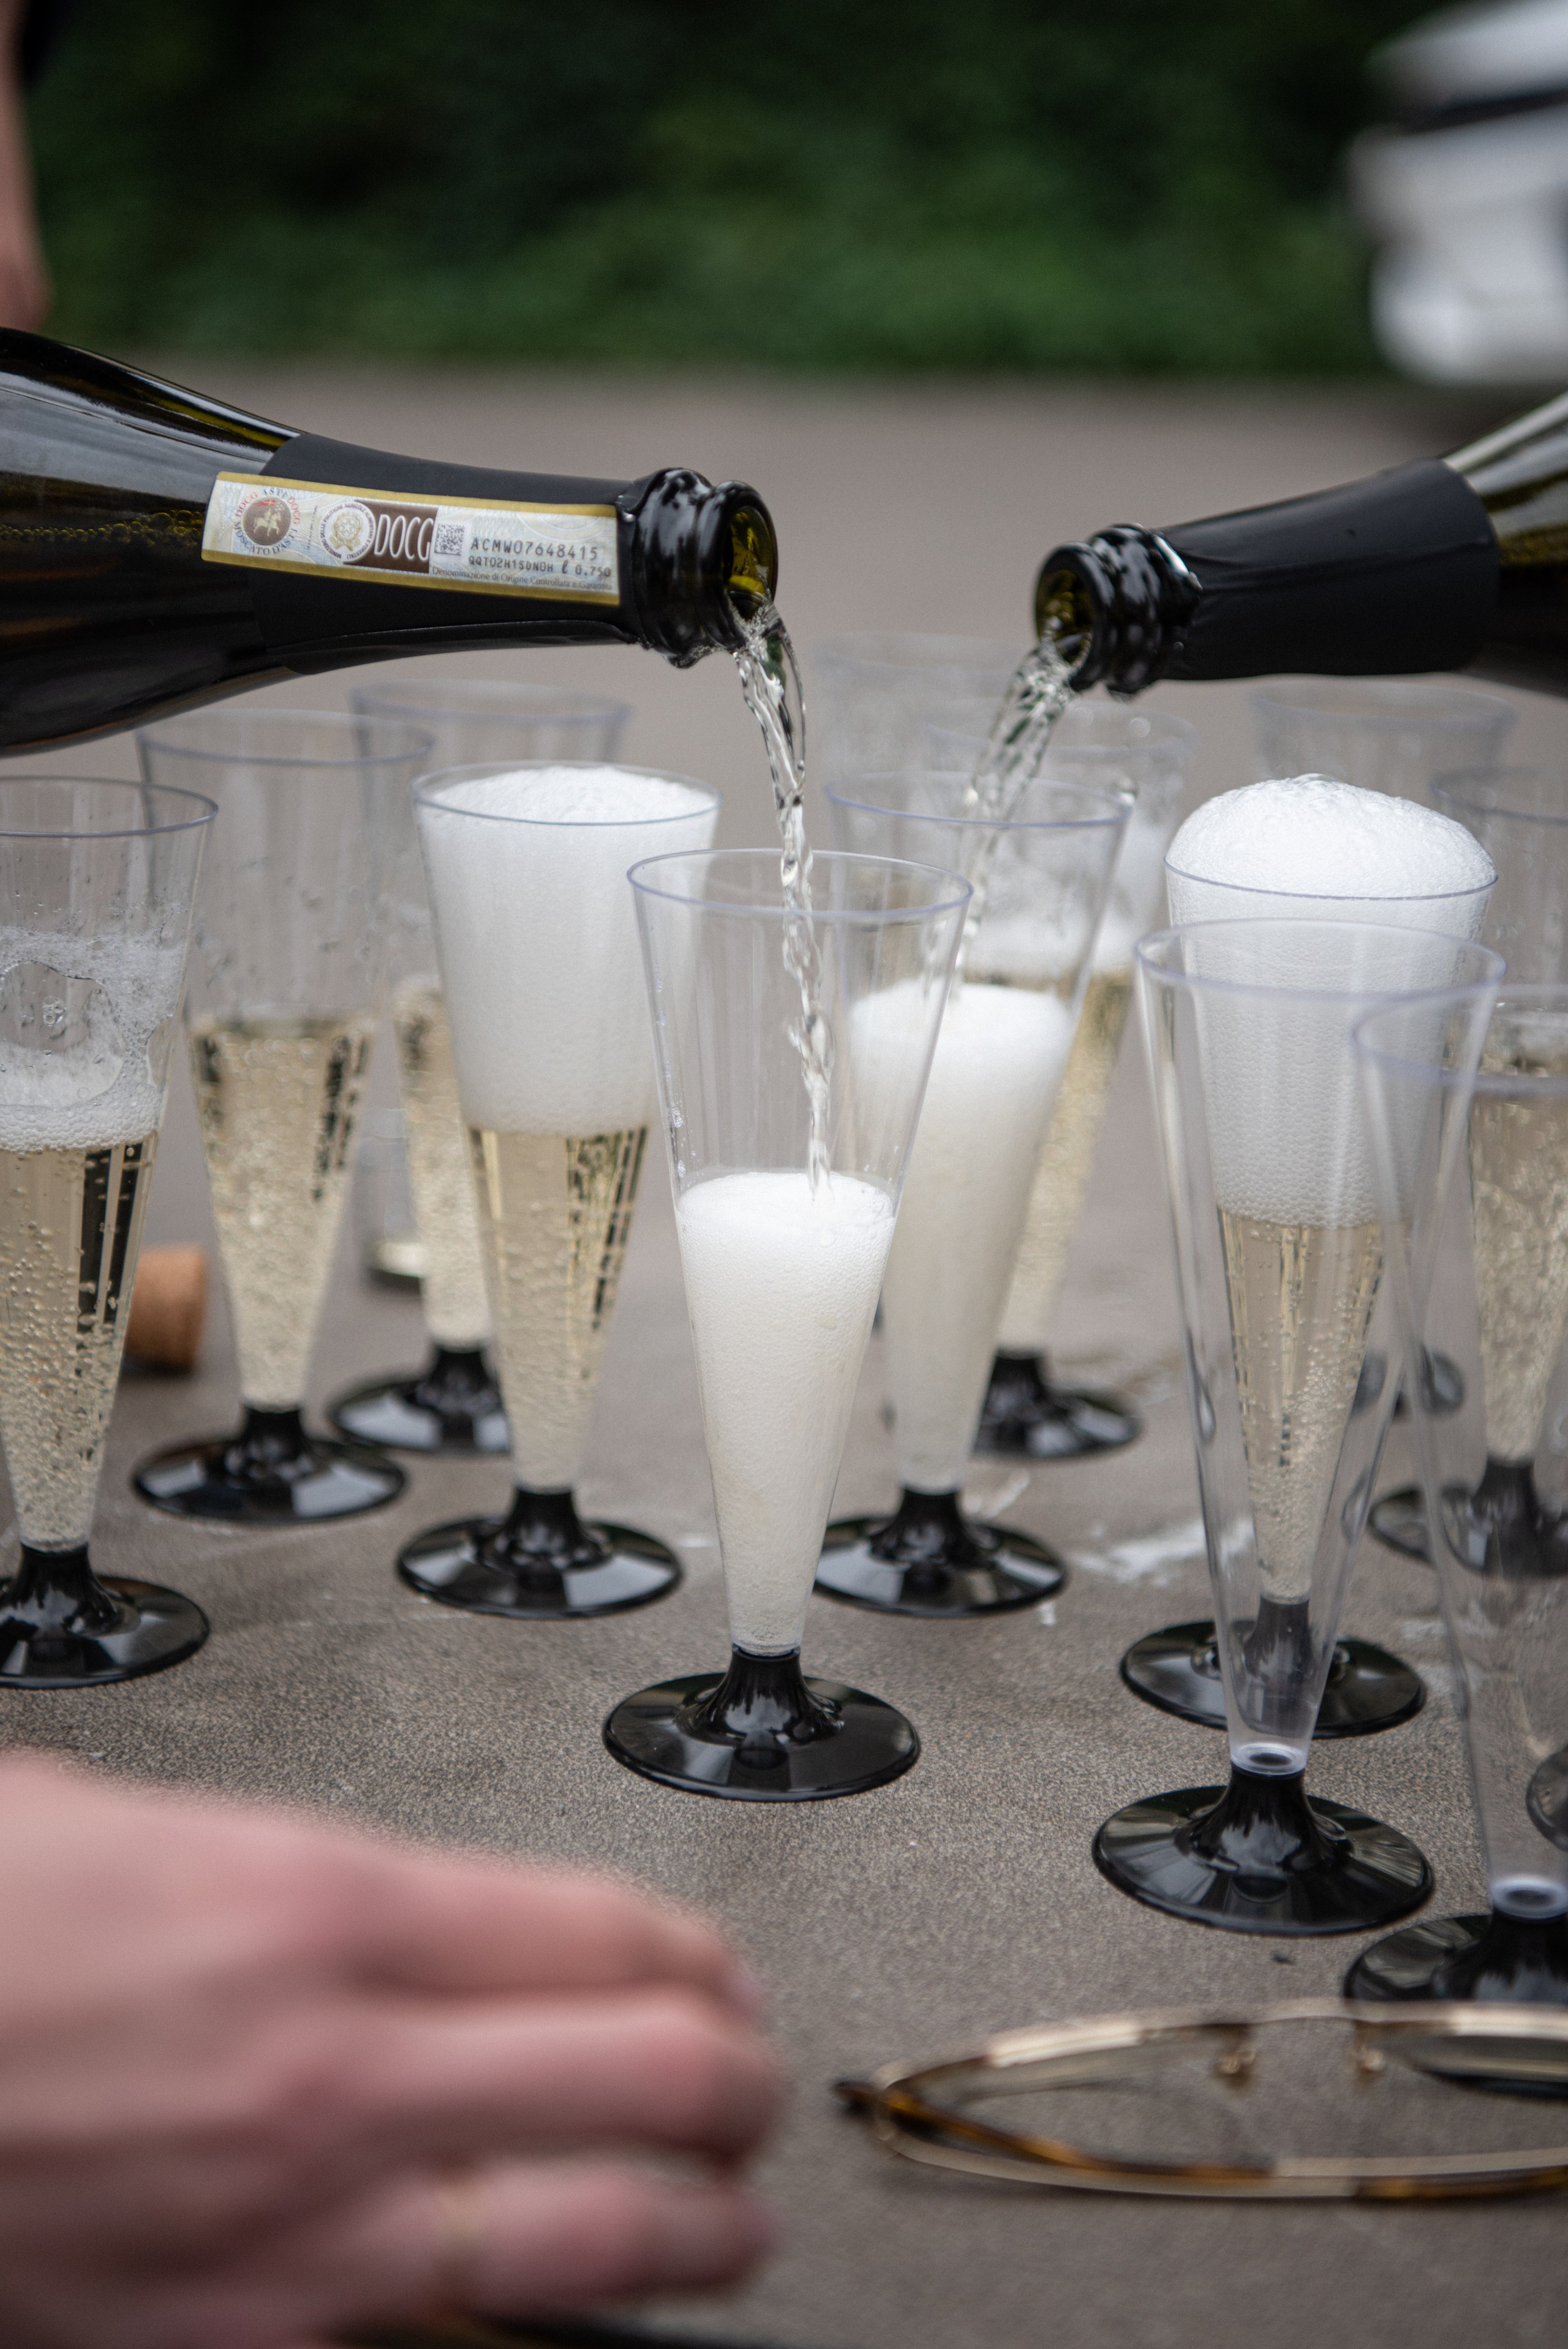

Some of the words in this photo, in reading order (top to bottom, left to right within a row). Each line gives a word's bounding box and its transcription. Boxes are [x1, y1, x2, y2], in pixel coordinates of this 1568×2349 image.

[287, 497, 301, 525] DOCG
[234, 521, 270, 555] MOSCATO
[272, 528, 298, 554] D'ASTI
[374, 514, 434, 560] DOCG
[432, 567, 490, 580] Denominazione
[500, 573, 528, 584] Origine
[530, 576, 570, 587] Controllata
[575, 564, 611, 578] 0.750
